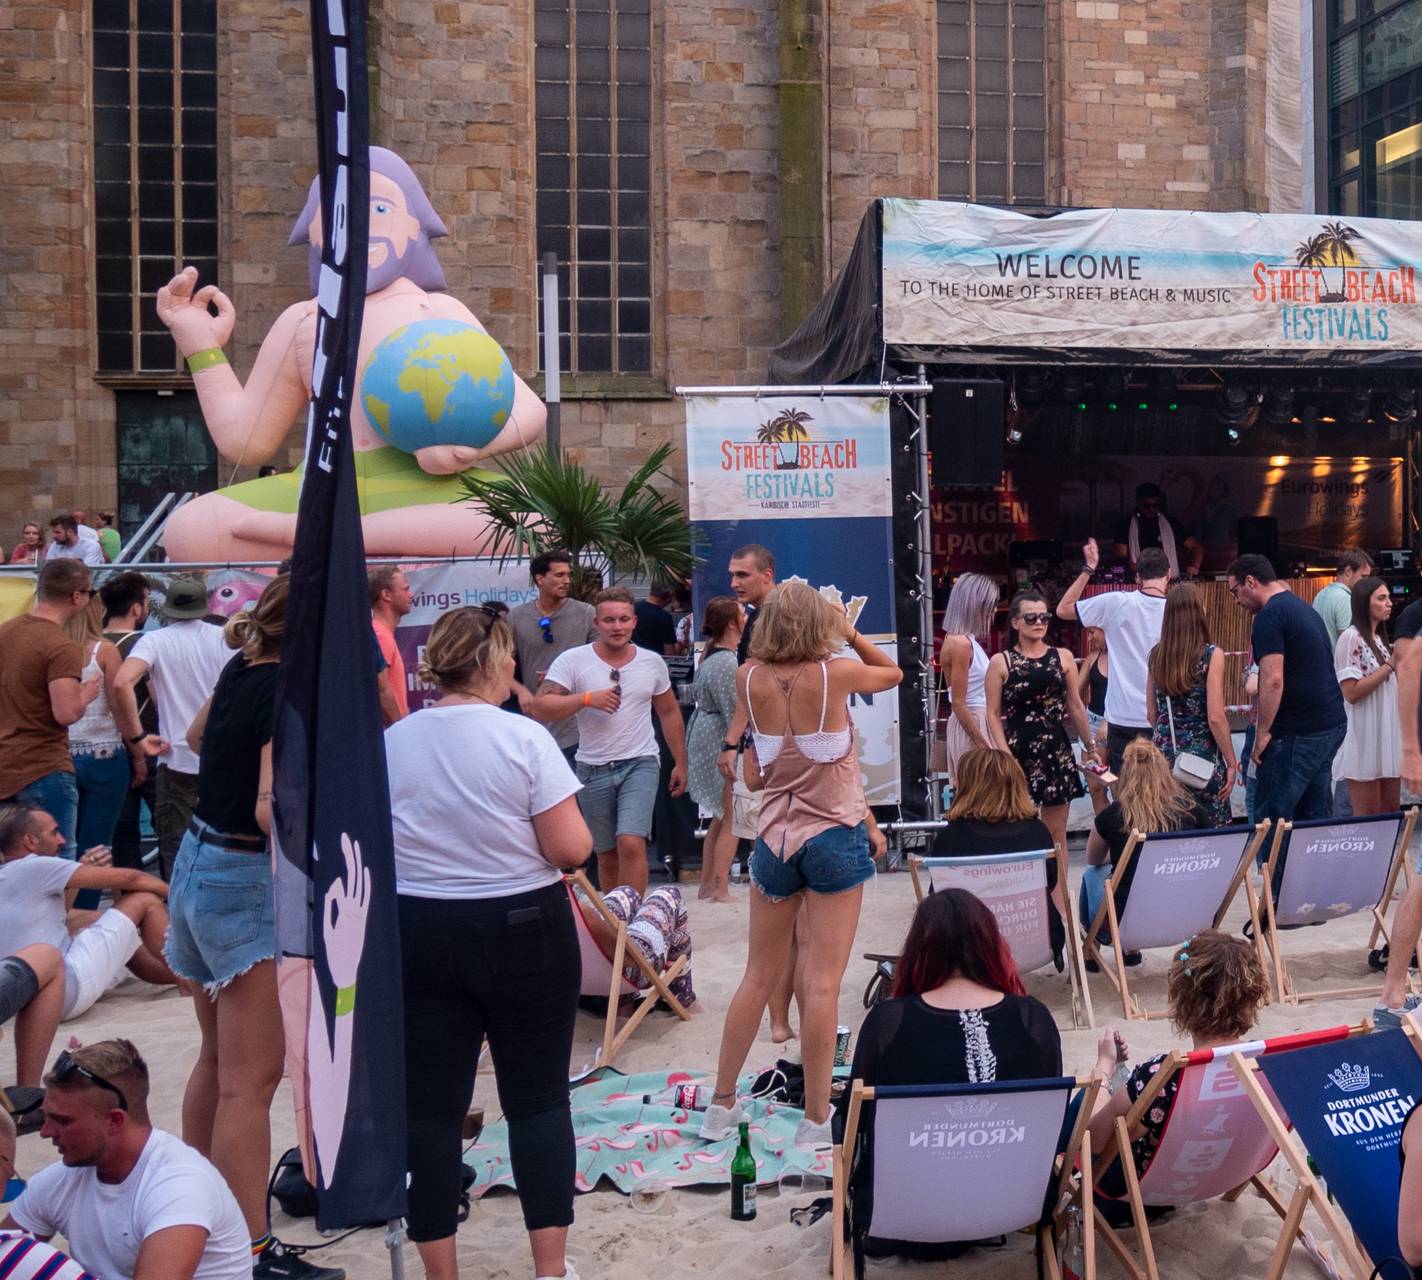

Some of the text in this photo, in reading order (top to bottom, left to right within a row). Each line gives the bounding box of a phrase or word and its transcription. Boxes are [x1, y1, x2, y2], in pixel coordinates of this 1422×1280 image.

[997, 253, 1141, 281] WELCOME
[901, 280, 1232, 304] TO THE HOME OF STREET BEACH & MUSIC
[1252, 261, 1416, 305] STREET BEACH
[1281, 305, 1389, 343] FESTIVALS
[721, 438, 858, 471] STREET BEACH
[746, 472, 834, 499] FESTIVALS
[1281, 479, 1369, 498] Eurowings
[1327, 1088, 1399, 1111] DORTMUNDER
